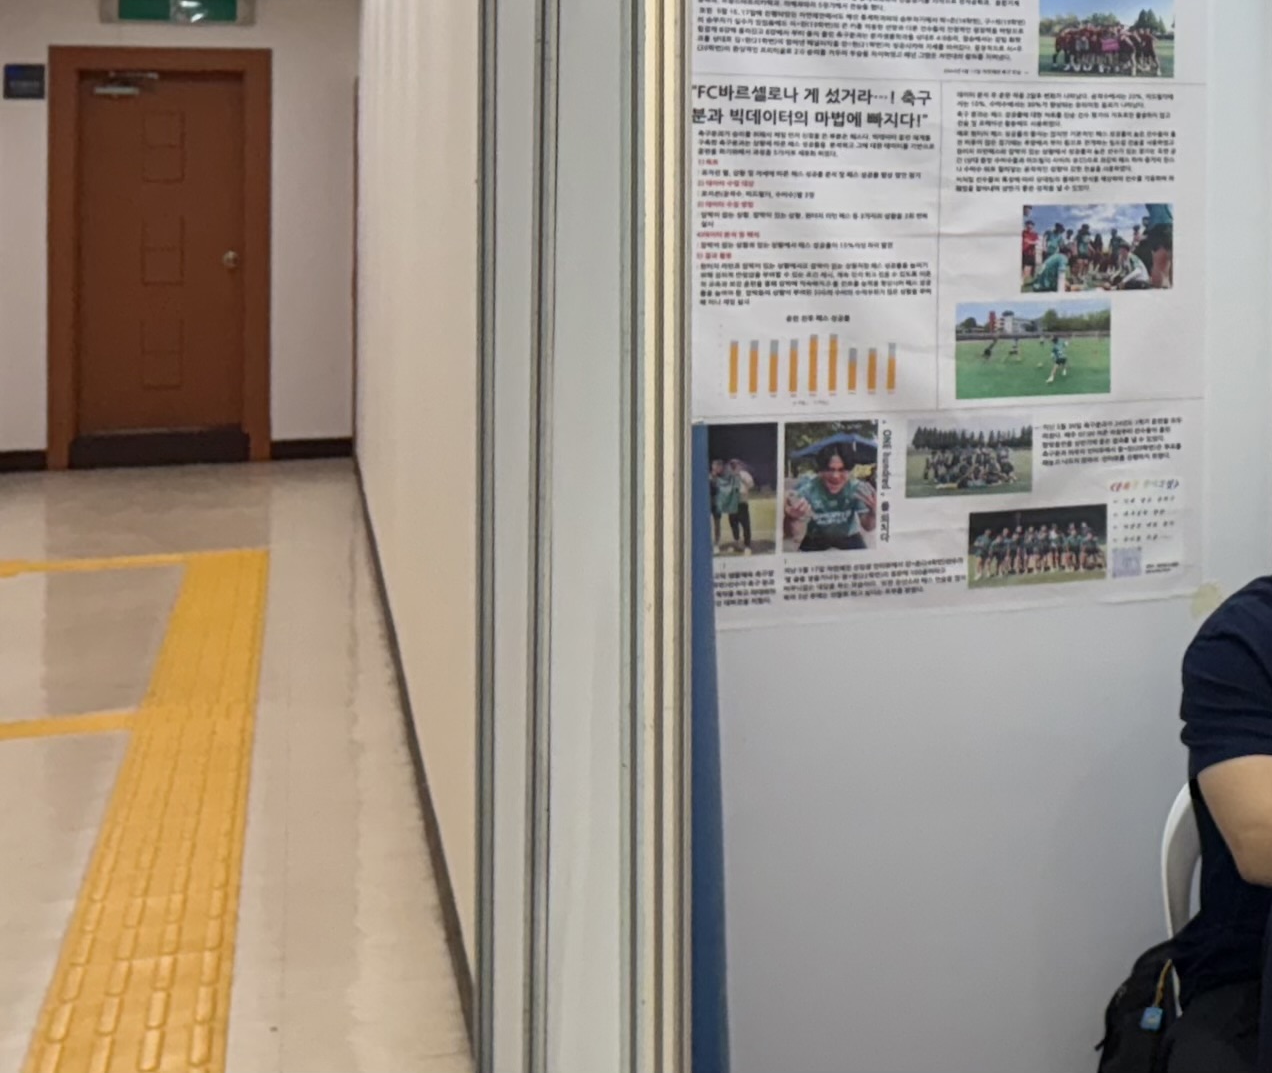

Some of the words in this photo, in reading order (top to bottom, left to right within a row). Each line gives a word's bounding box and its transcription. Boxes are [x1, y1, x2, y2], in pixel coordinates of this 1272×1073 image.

[803, 86, 820, 104] 게
[900, 90, 932, 107] 축구
[691, 107, 724, 125] 분과
[730, 108, 809, 127] 빅데이터의
[814, 110, 862, 128] 마법에
[882, 429, 892, 449] ONE
